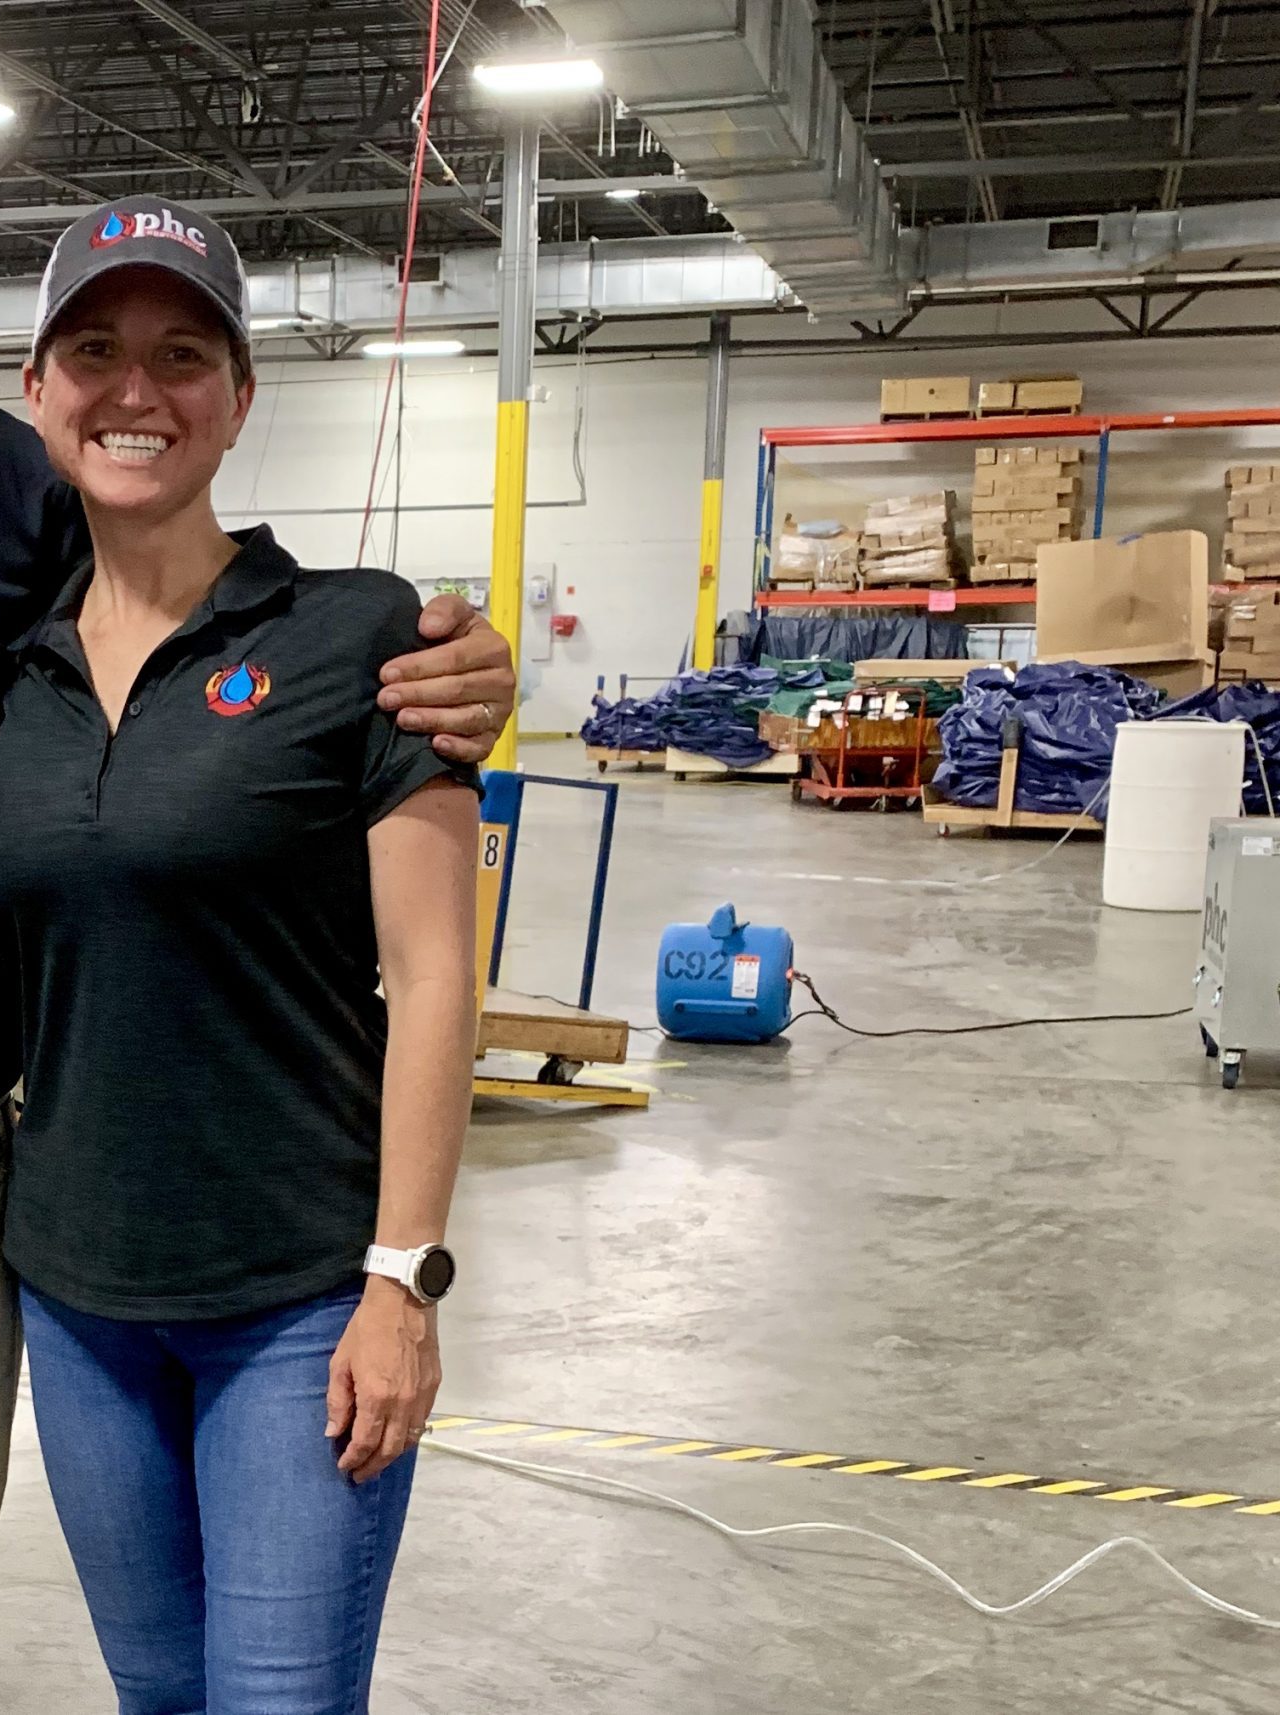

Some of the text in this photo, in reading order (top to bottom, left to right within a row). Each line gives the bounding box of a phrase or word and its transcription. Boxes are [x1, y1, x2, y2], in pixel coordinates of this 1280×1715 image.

[132, 208, 207, 248] phc
[484, 833, 499, 867] 8
[1202, 881, 1228, 953] phc
[664, 949, 730, 981] C92
